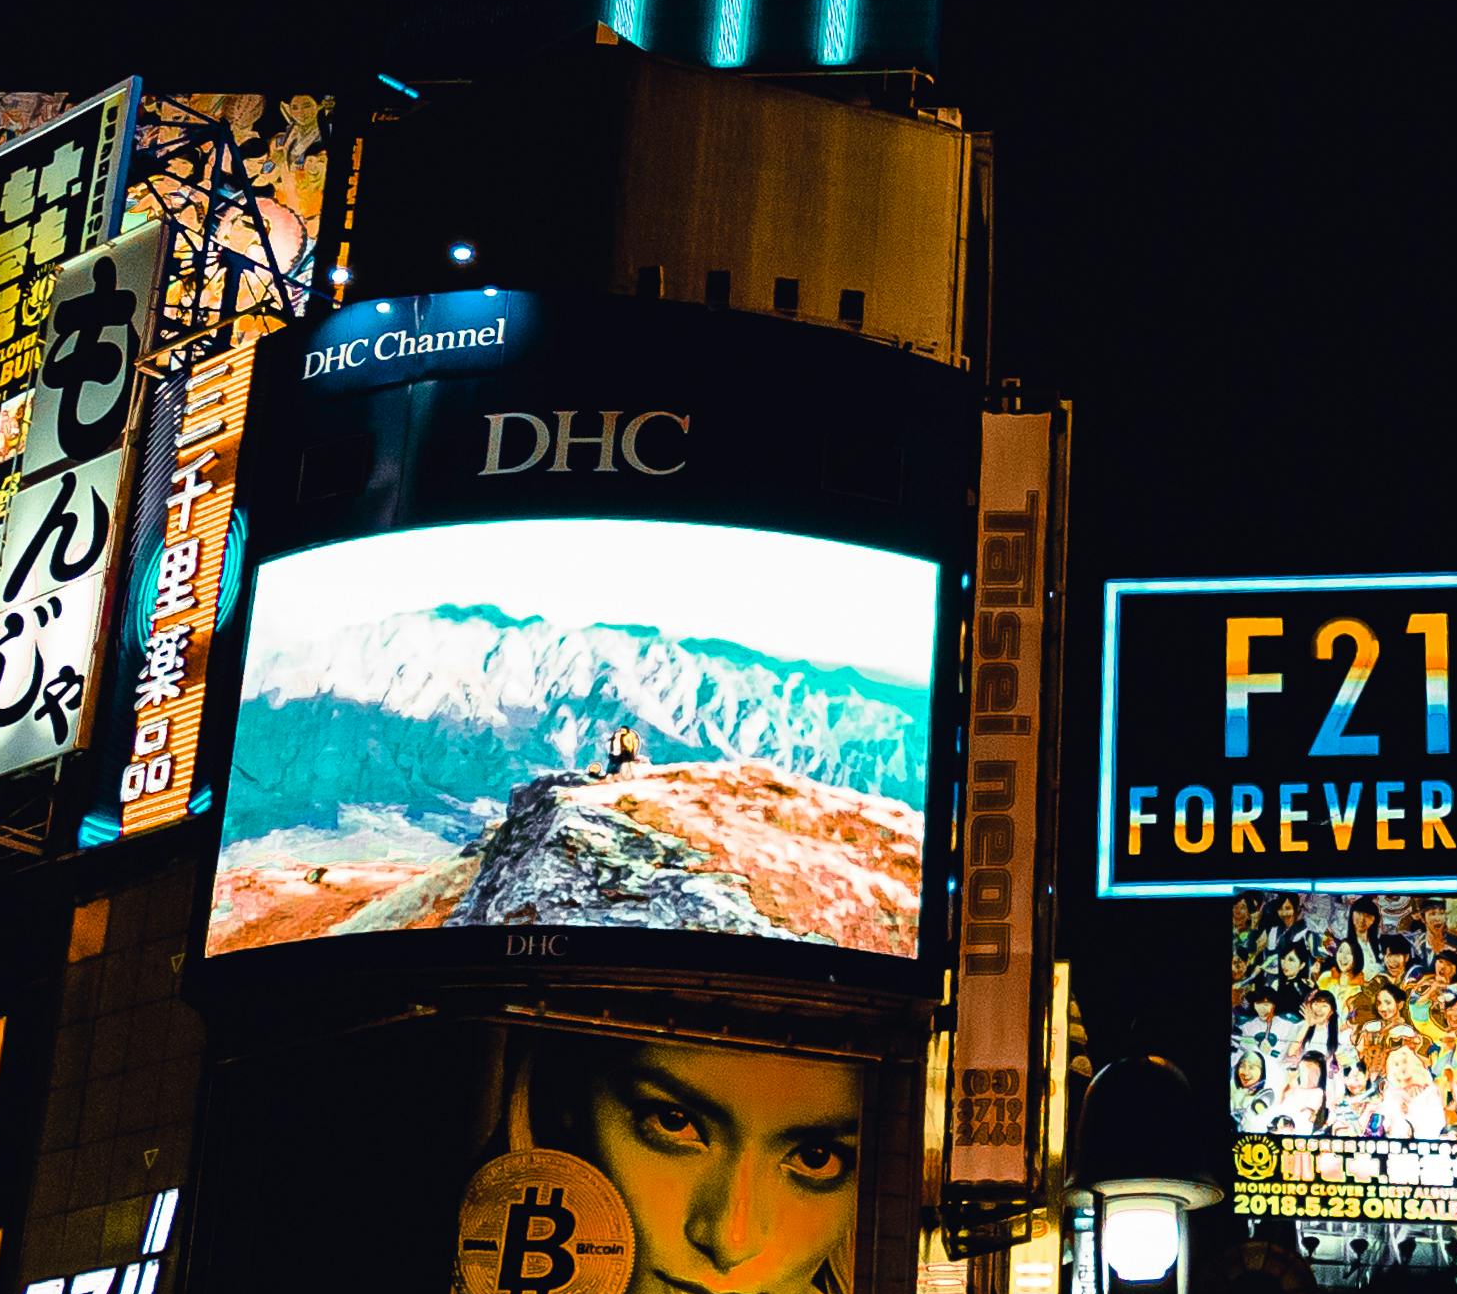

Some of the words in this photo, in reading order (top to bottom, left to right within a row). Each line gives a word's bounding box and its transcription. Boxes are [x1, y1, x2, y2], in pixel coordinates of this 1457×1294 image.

[303, 341, 369, 380] DHC
[374, 317, 506, 362] Channel
[476, 411, 692, 477] DHC
[119, 360, 231, 803] 三千里薬品
[976, 490, 1040, 737] Taisei
[1224, 612, 1450, 758] F21
[1128, 780, 1456, 855] FOREVER
[964, 759, 1017, 978] neon
[504, 934, 569, 958] DHC
[1234, 1182, 1307, 1195] MOMOIRO
[1310, 1184, 1364, 1197] CLOVER
[1234, 1194, 1361, 1219] 2018.5.23
[1363, 1198, 1402, 1219] ON
[576, 1242, 624, 1257] Bitcoin
